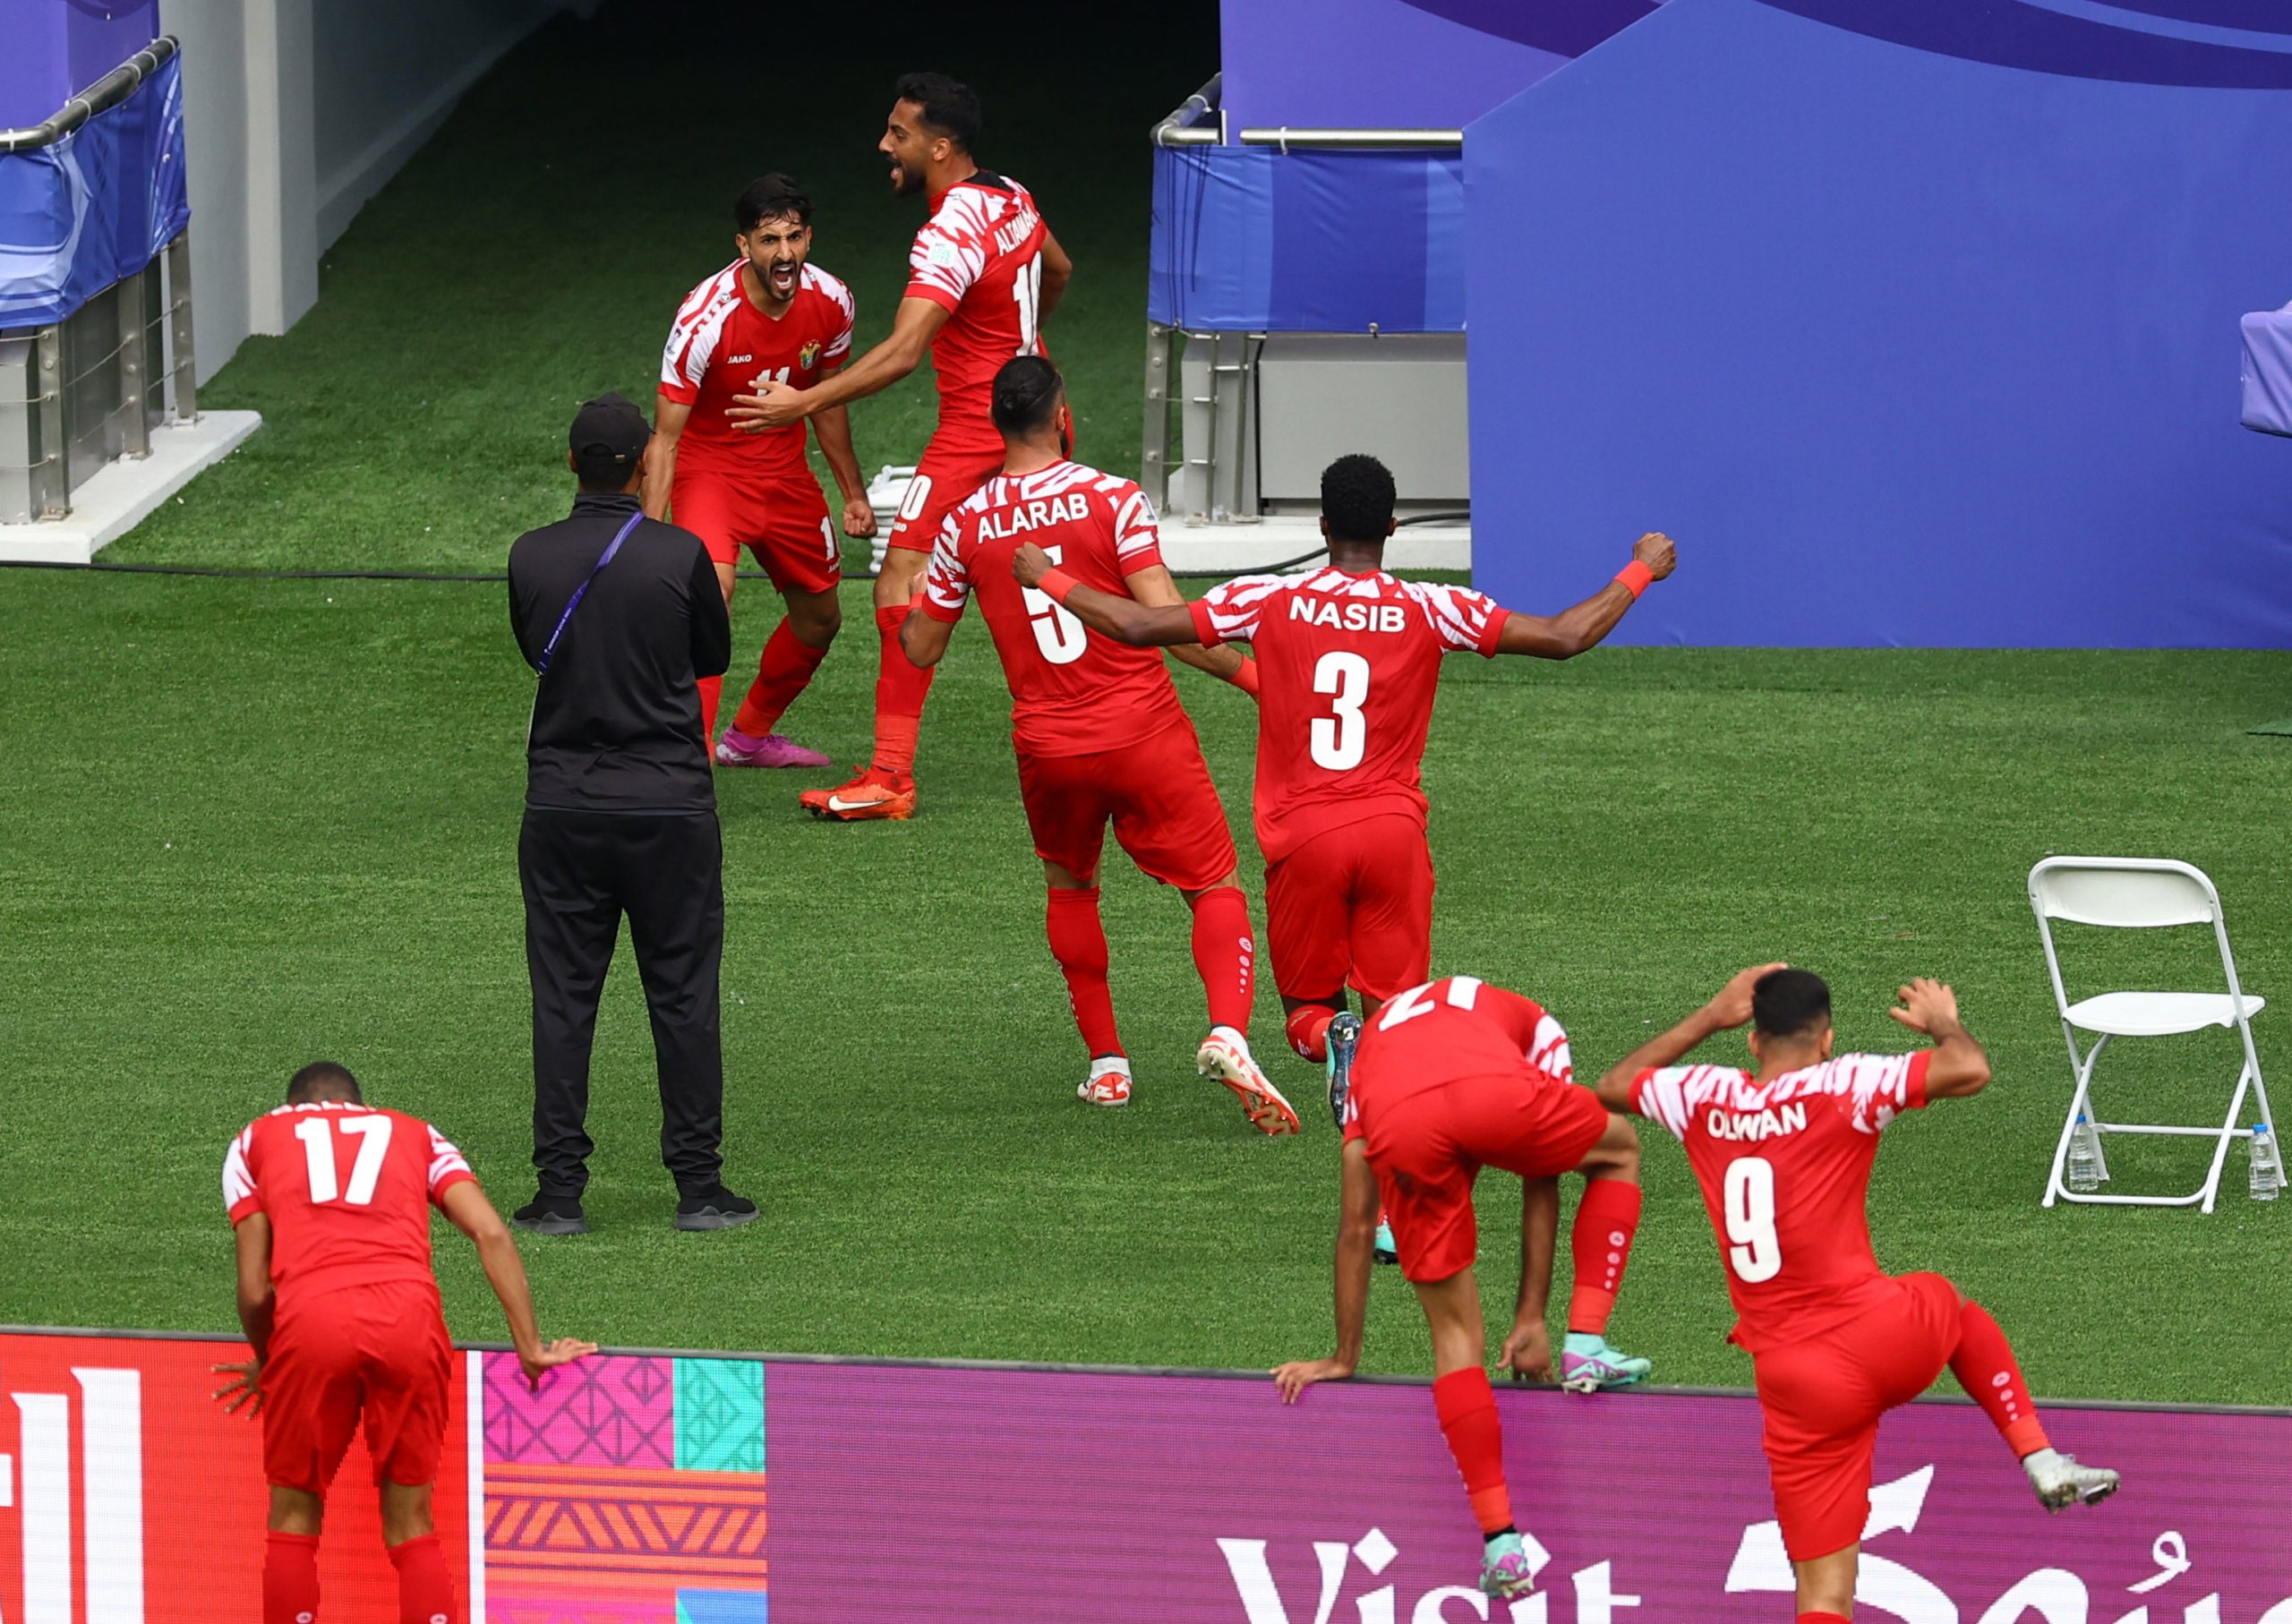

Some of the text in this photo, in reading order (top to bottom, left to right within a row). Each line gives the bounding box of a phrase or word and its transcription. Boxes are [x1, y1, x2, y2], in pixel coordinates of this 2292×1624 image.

[727, 354, 753, 364] JAKO
[978, 493, 1090, 544] ALARAB
[1021, 544, 1088, 665] 5
[1289, 595, 1407, 633] NASIB
[1310, 651, 1371, 772] 3
[1707, 1101, 1808, 1142] OLWAN
[294, 1114, 393, 1206] 17
[1723, 1156, 1783, 1284] 9
